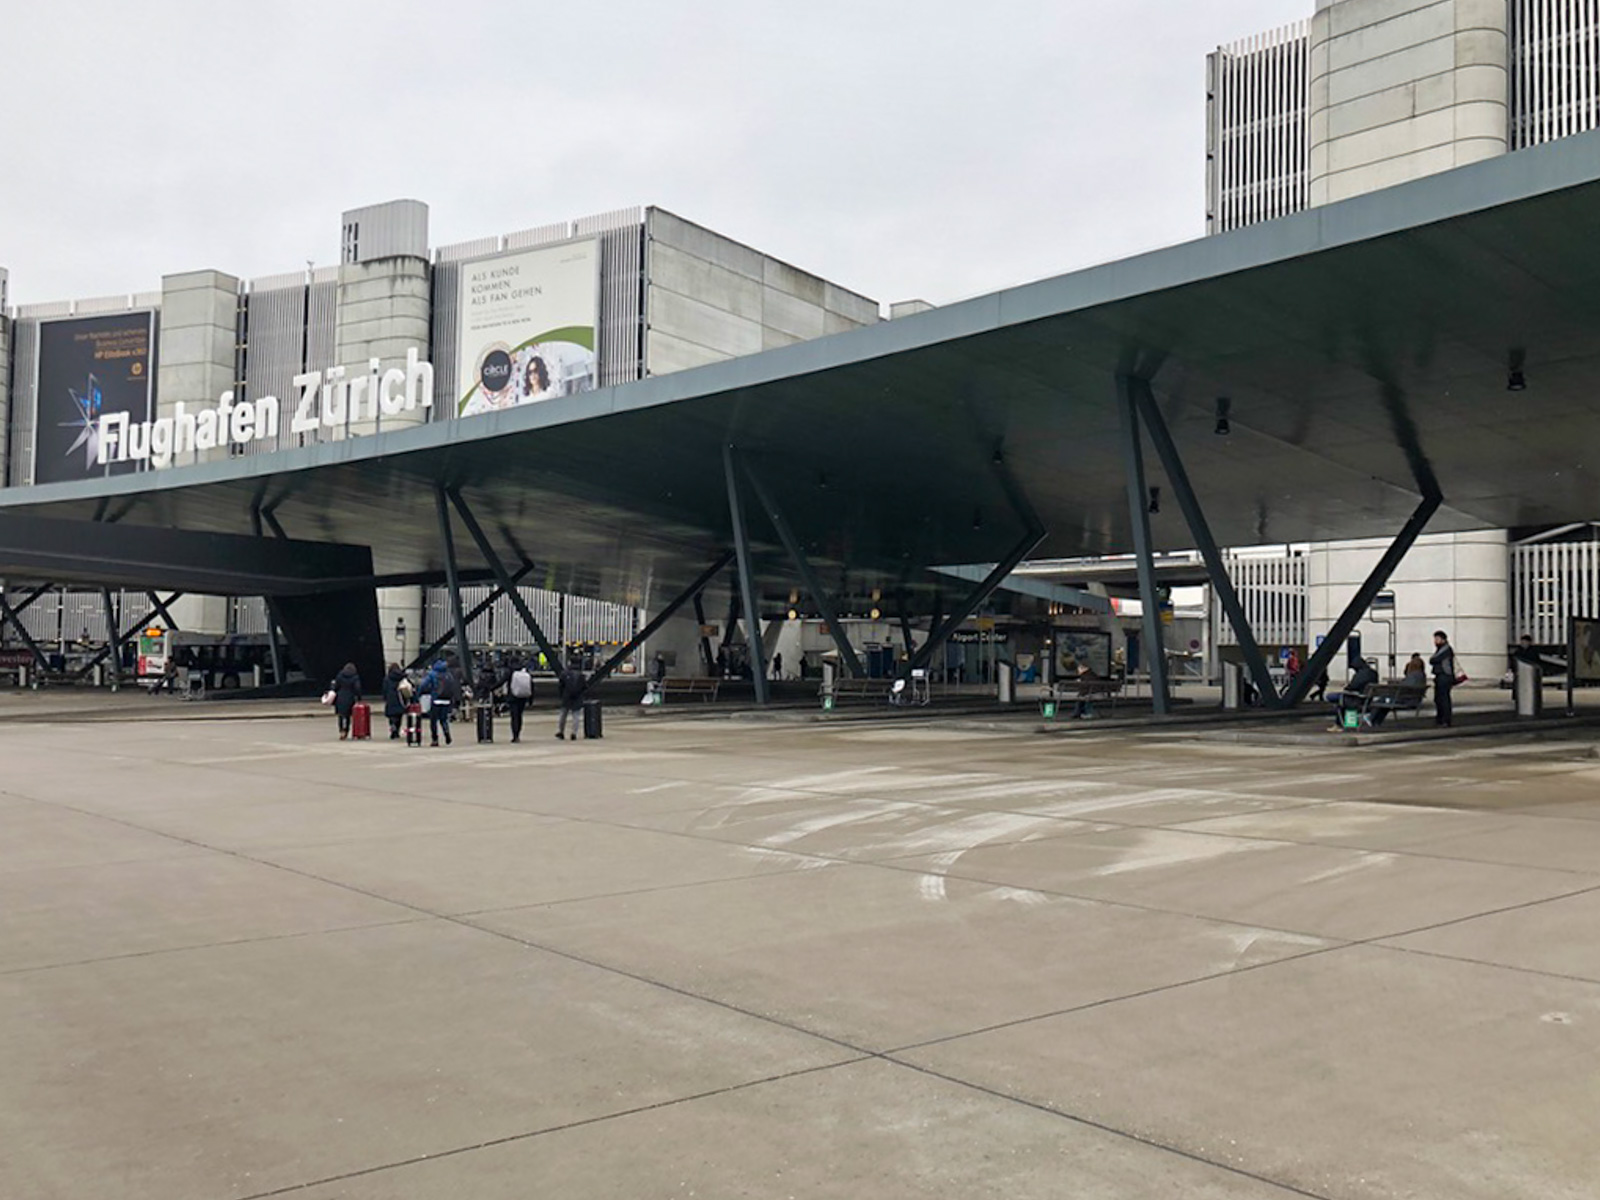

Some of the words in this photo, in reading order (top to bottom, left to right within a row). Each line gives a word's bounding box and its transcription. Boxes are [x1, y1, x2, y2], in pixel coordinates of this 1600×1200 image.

[471, 272, 487, 282] ALS
[490, 266, 520, 279] KUNDE
[471, 280, 511, 294] KOMMEN
[471, 296, 487, 306] ALS
[490, 292, 508, 303] FAN
[511, 285, 543, 299] GEHEN
[97, 390, 279, 468] Flughafen
[291, 346, 434, 433] Zürich
[952, 632, 978, 643] Airport
